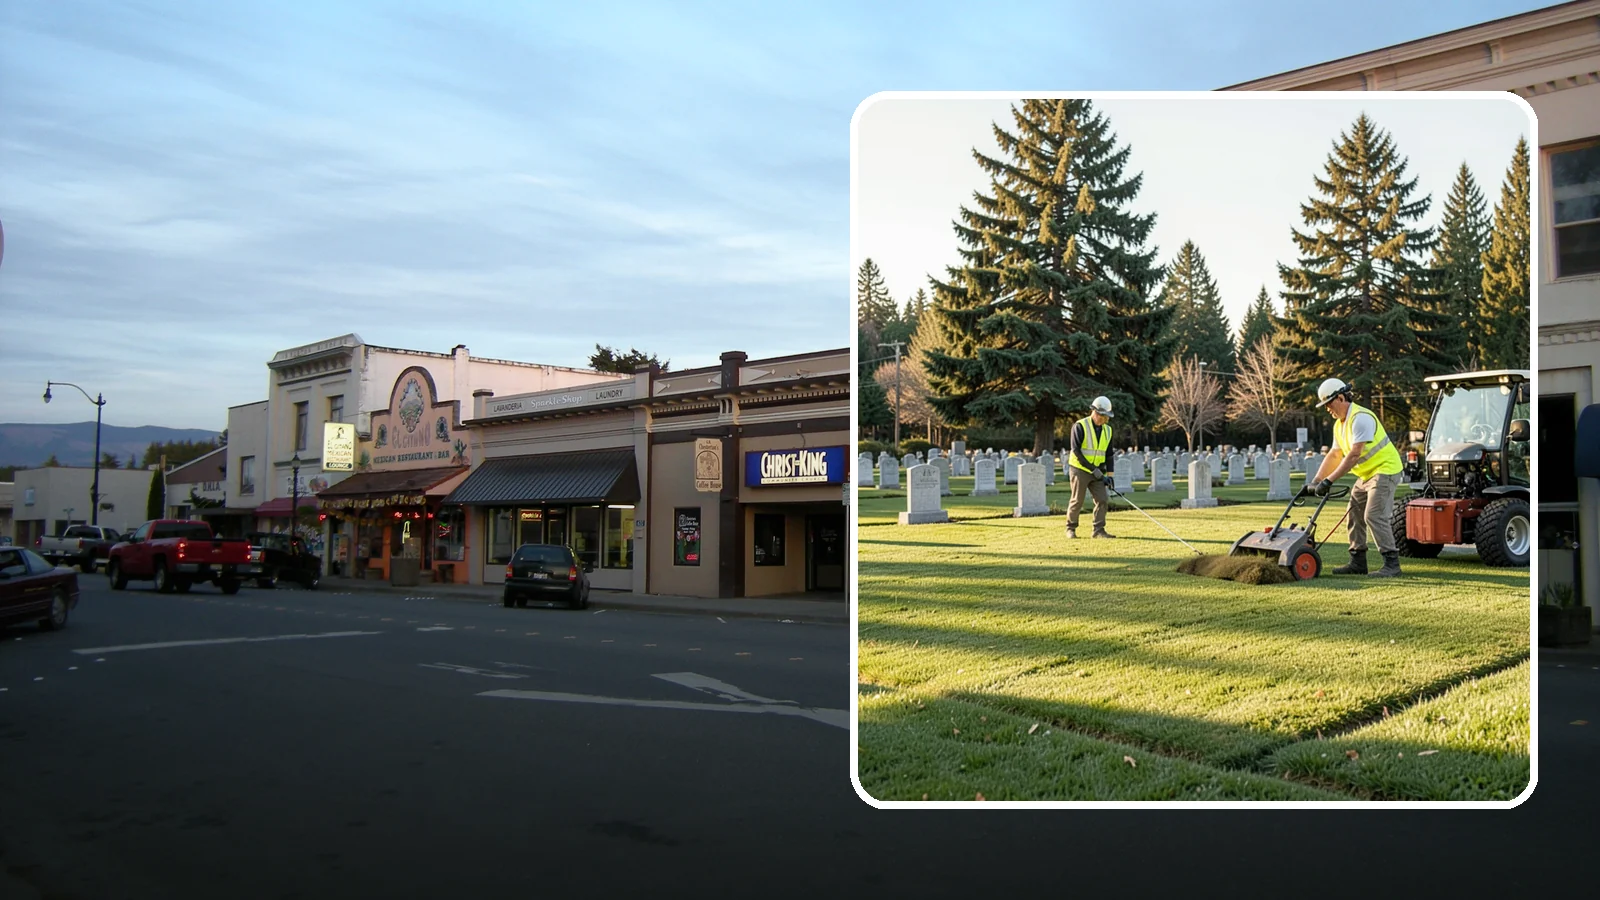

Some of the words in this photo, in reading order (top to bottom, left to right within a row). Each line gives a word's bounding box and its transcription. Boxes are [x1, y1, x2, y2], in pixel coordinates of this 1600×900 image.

[595, 389, 624, 400] LAUNDRY
[493, 401, 523, 413] LAVANDERIA
[530, 396, 562, 410] Sparkle
[562, 395, 583, 406] Shop
[374, 455, 396, 464] MEXICAN
[397, 451, 433, 462] RESTAURANT
[438, 450, 450, 459] BAR
[799, 450, 828, 476] KING
[697, 481, 709, 489] Coffee
